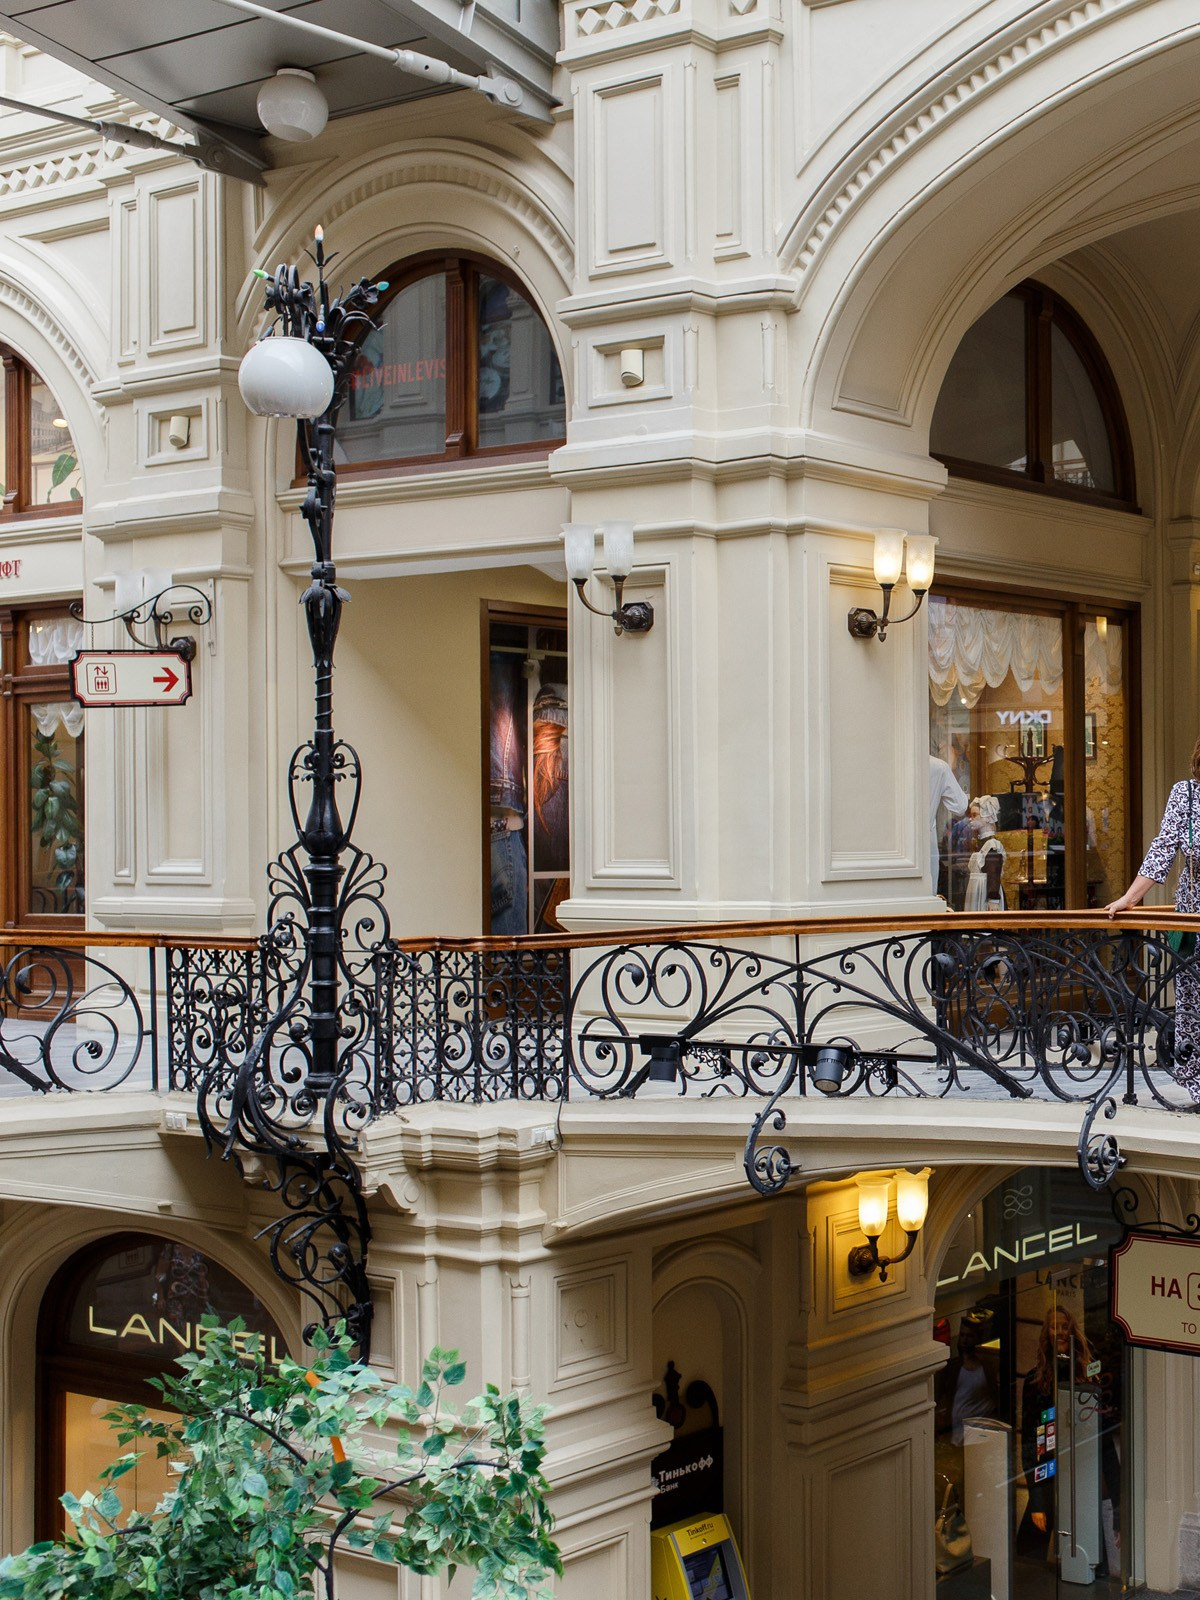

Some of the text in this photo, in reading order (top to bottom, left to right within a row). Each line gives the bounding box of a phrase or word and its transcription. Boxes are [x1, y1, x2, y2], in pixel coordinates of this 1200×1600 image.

[0, 559, 22, 577] ФТ
[1151, 1275, 1183, 1300] НА
[1181, 1322, 1197, 1335] TO
[659, 1454, 714, 1482] Тинькофф
[660, 1481, 679, 1494] Банк
[686, 1522, 714, 1537] Tinkoff.ru
